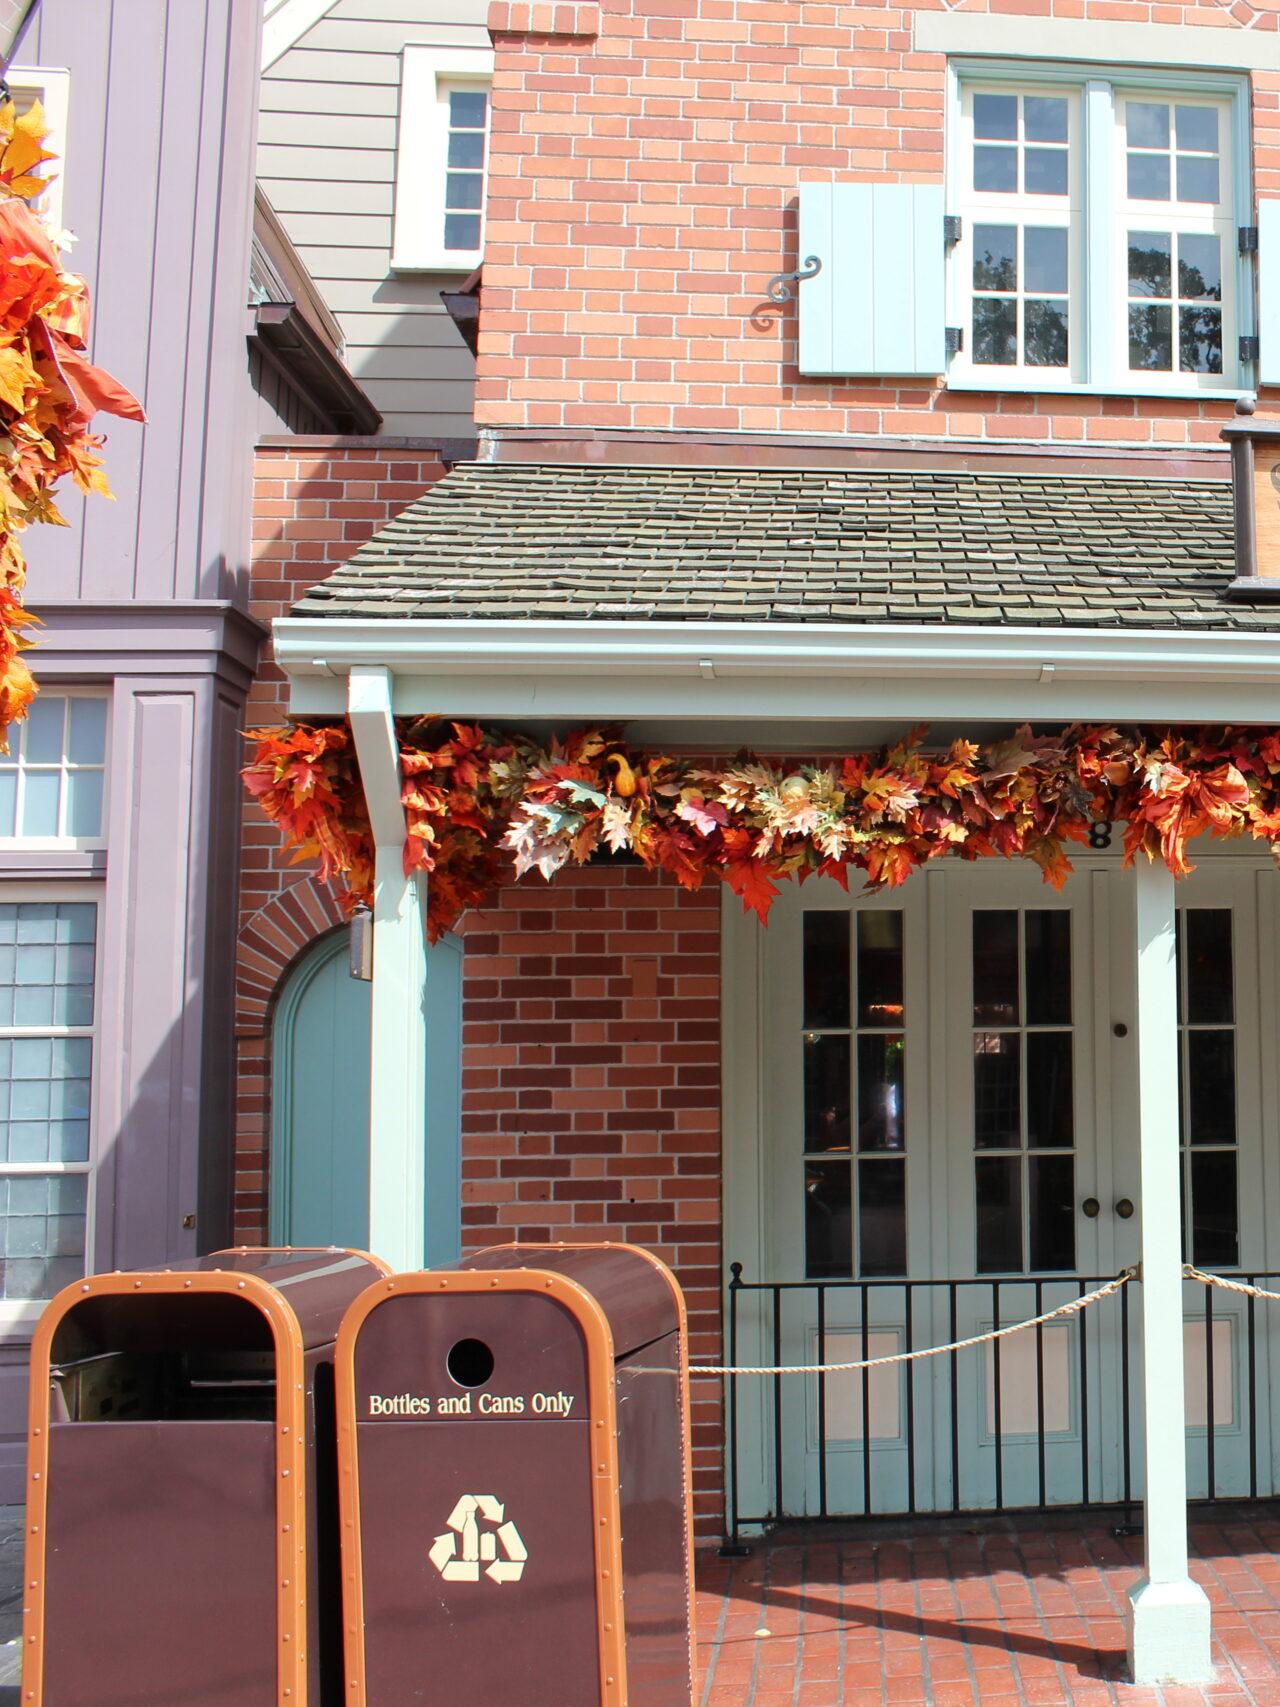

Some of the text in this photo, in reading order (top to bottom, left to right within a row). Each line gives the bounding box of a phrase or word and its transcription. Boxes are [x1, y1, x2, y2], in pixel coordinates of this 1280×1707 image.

[1089, 820, 1112, 849] 8
[369, 1391, 574, 1417] Bottles and Cans Only
